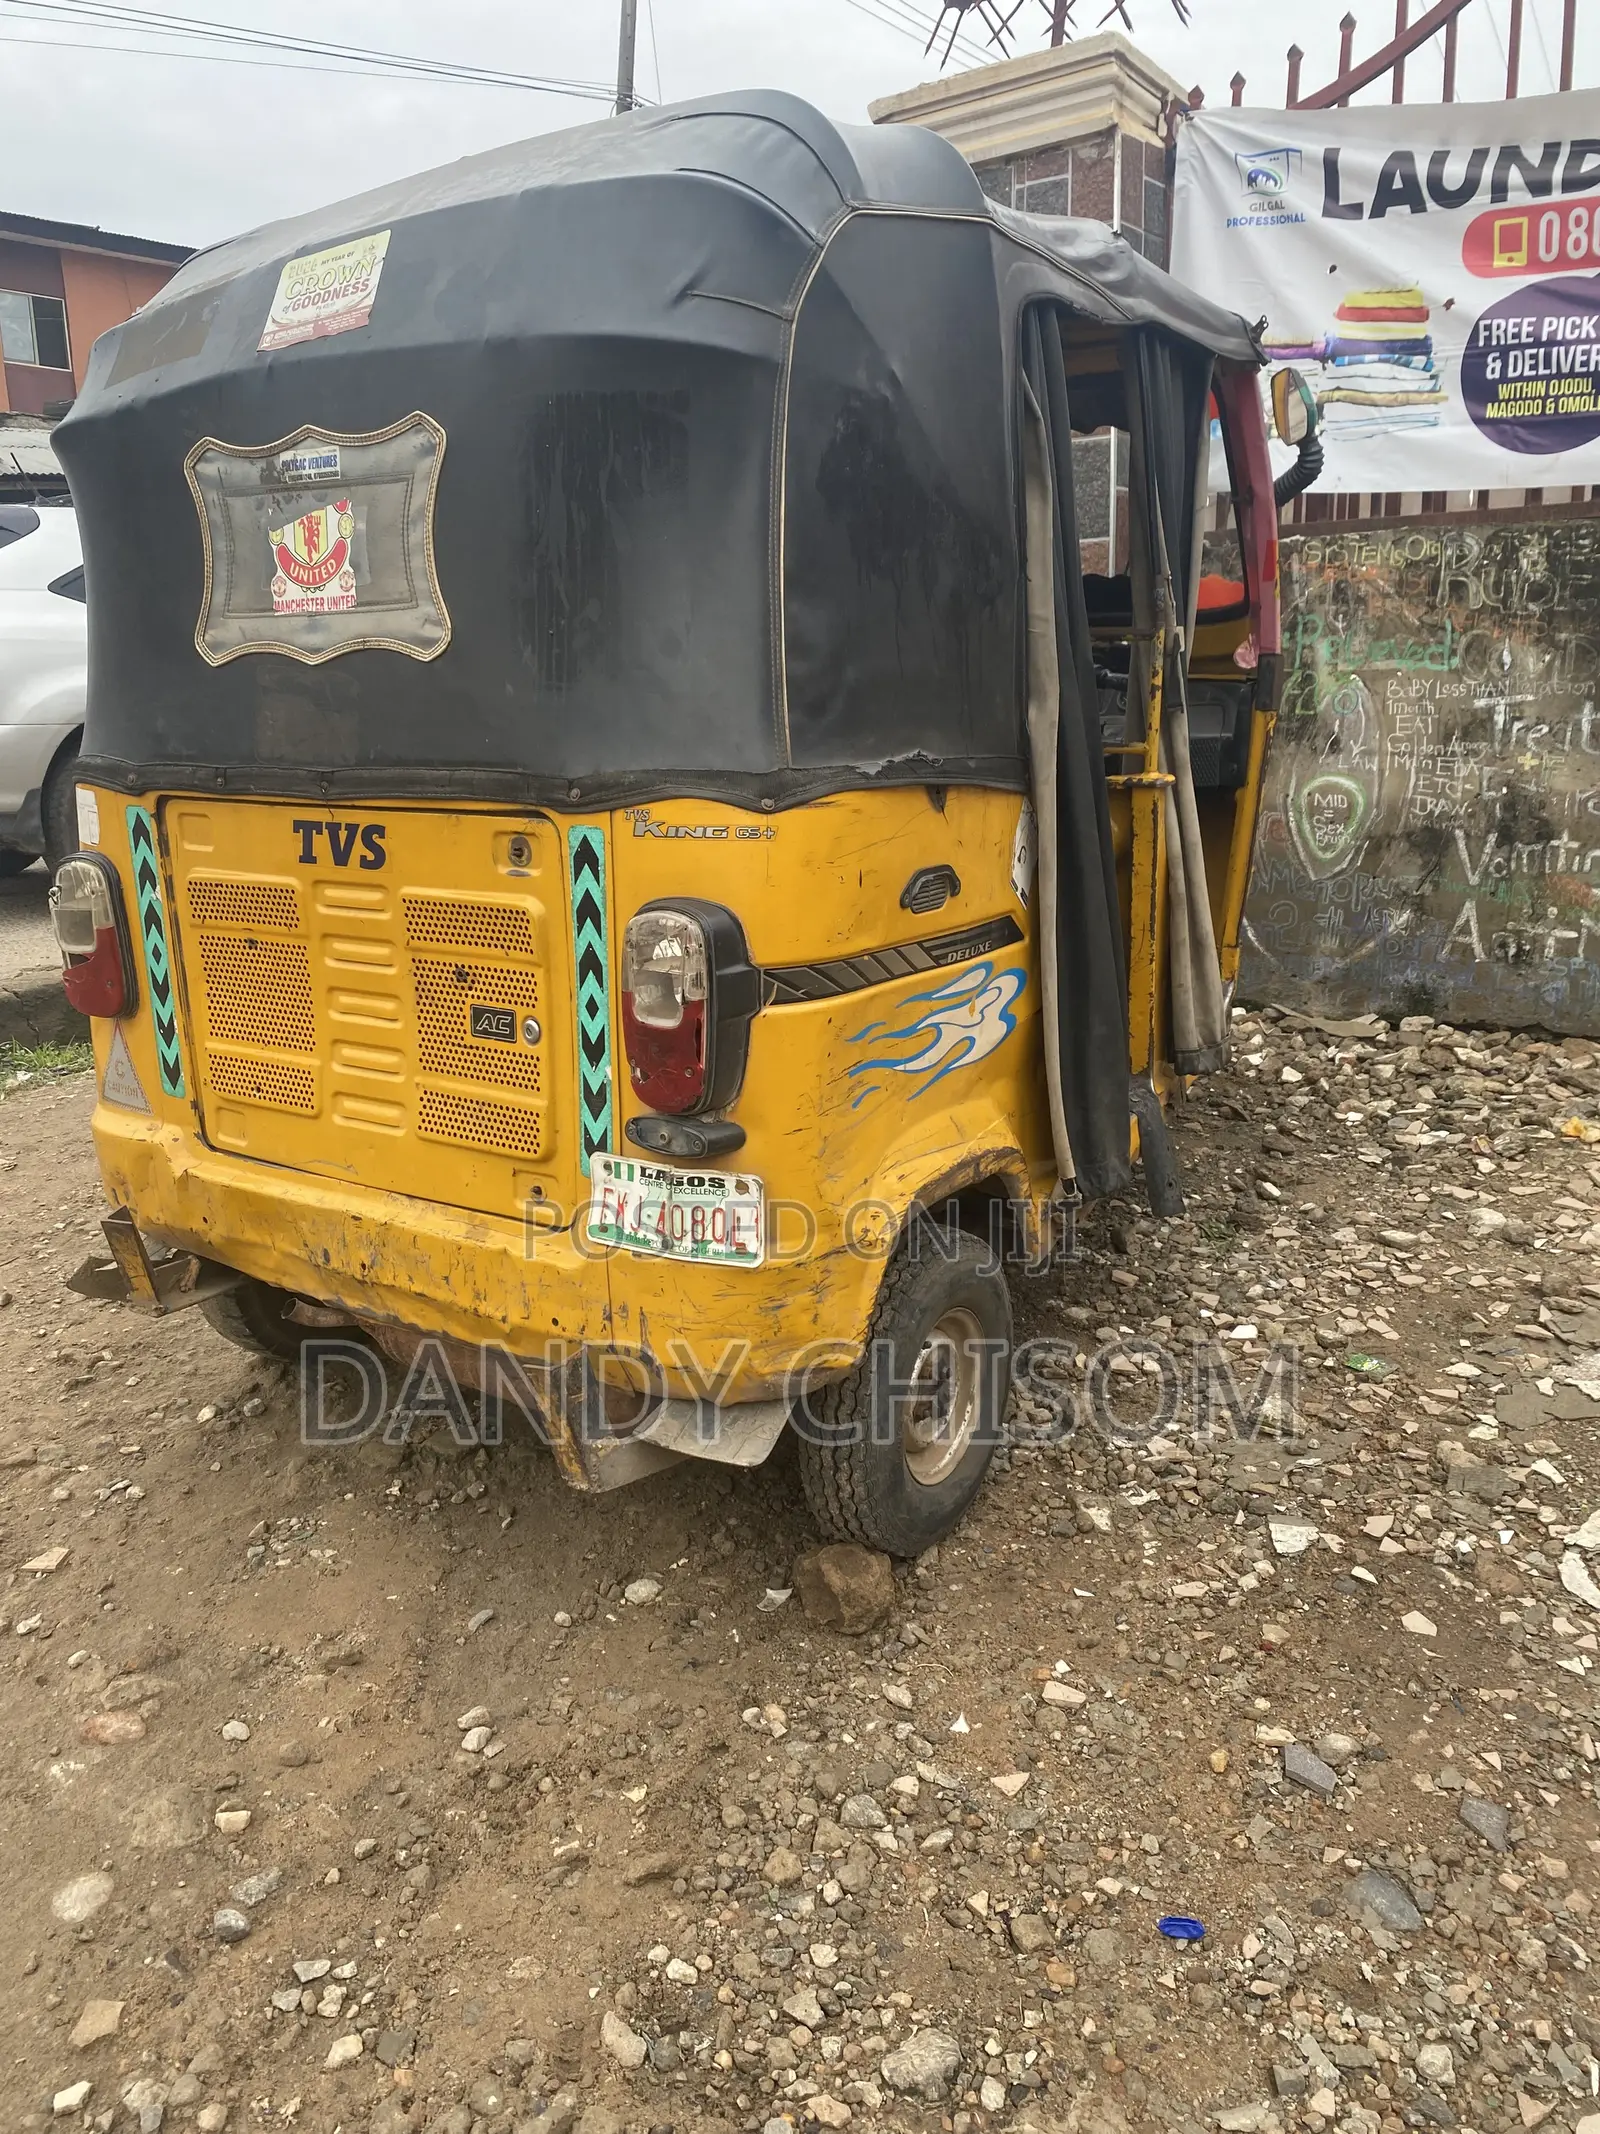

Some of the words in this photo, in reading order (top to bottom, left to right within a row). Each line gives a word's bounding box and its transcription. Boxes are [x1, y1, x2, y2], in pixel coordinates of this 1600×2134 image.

[1321, 138, 1600, 220] LAUND
[1249, 200, 1285, 213] GILGAL
[1226, 212, 1306, 229] PROFESSIONAL
[285, 256, 376, 299] CROWN
[292, 279, 370, 311] GOODNESS
[1478, 317, 1537, 347] FREE
[1541, 315, 1600, 342] PICK
[1485, 352, 1502, 380] &
[1498, 380, 1547, 400] WITHIN
[1549, 377, 1596, 397] OJODU,
[1486, 399, 1543, 419] MAGODO
[1545, 398, 1556, 415] &
[308, 454, 338, 469] VENTURES
[290, 559, 337, 583] UNITED
[274, 596, 325, 613] MANCHESTER
[327, 594, 356, 609] UNITED
[1396, 715, 1439, 735] EAT
[1314, 793, 1348, 808] MID
[625, 809, 650, 820] TVS
[1313, 815, 1344, 834] Sex
[735, 826, 775, 839] GS+
[292, 819, 386, 871] TVS
[947, 940, 992, 963] DELUXE
[475, 1013, 513, 1034] AC
[639, 1178, 664, 1189] CENTRE
[673, 1187, 727, 1197] EXCELLENCE
[640, 1166, 726, 1189] LAGOS
